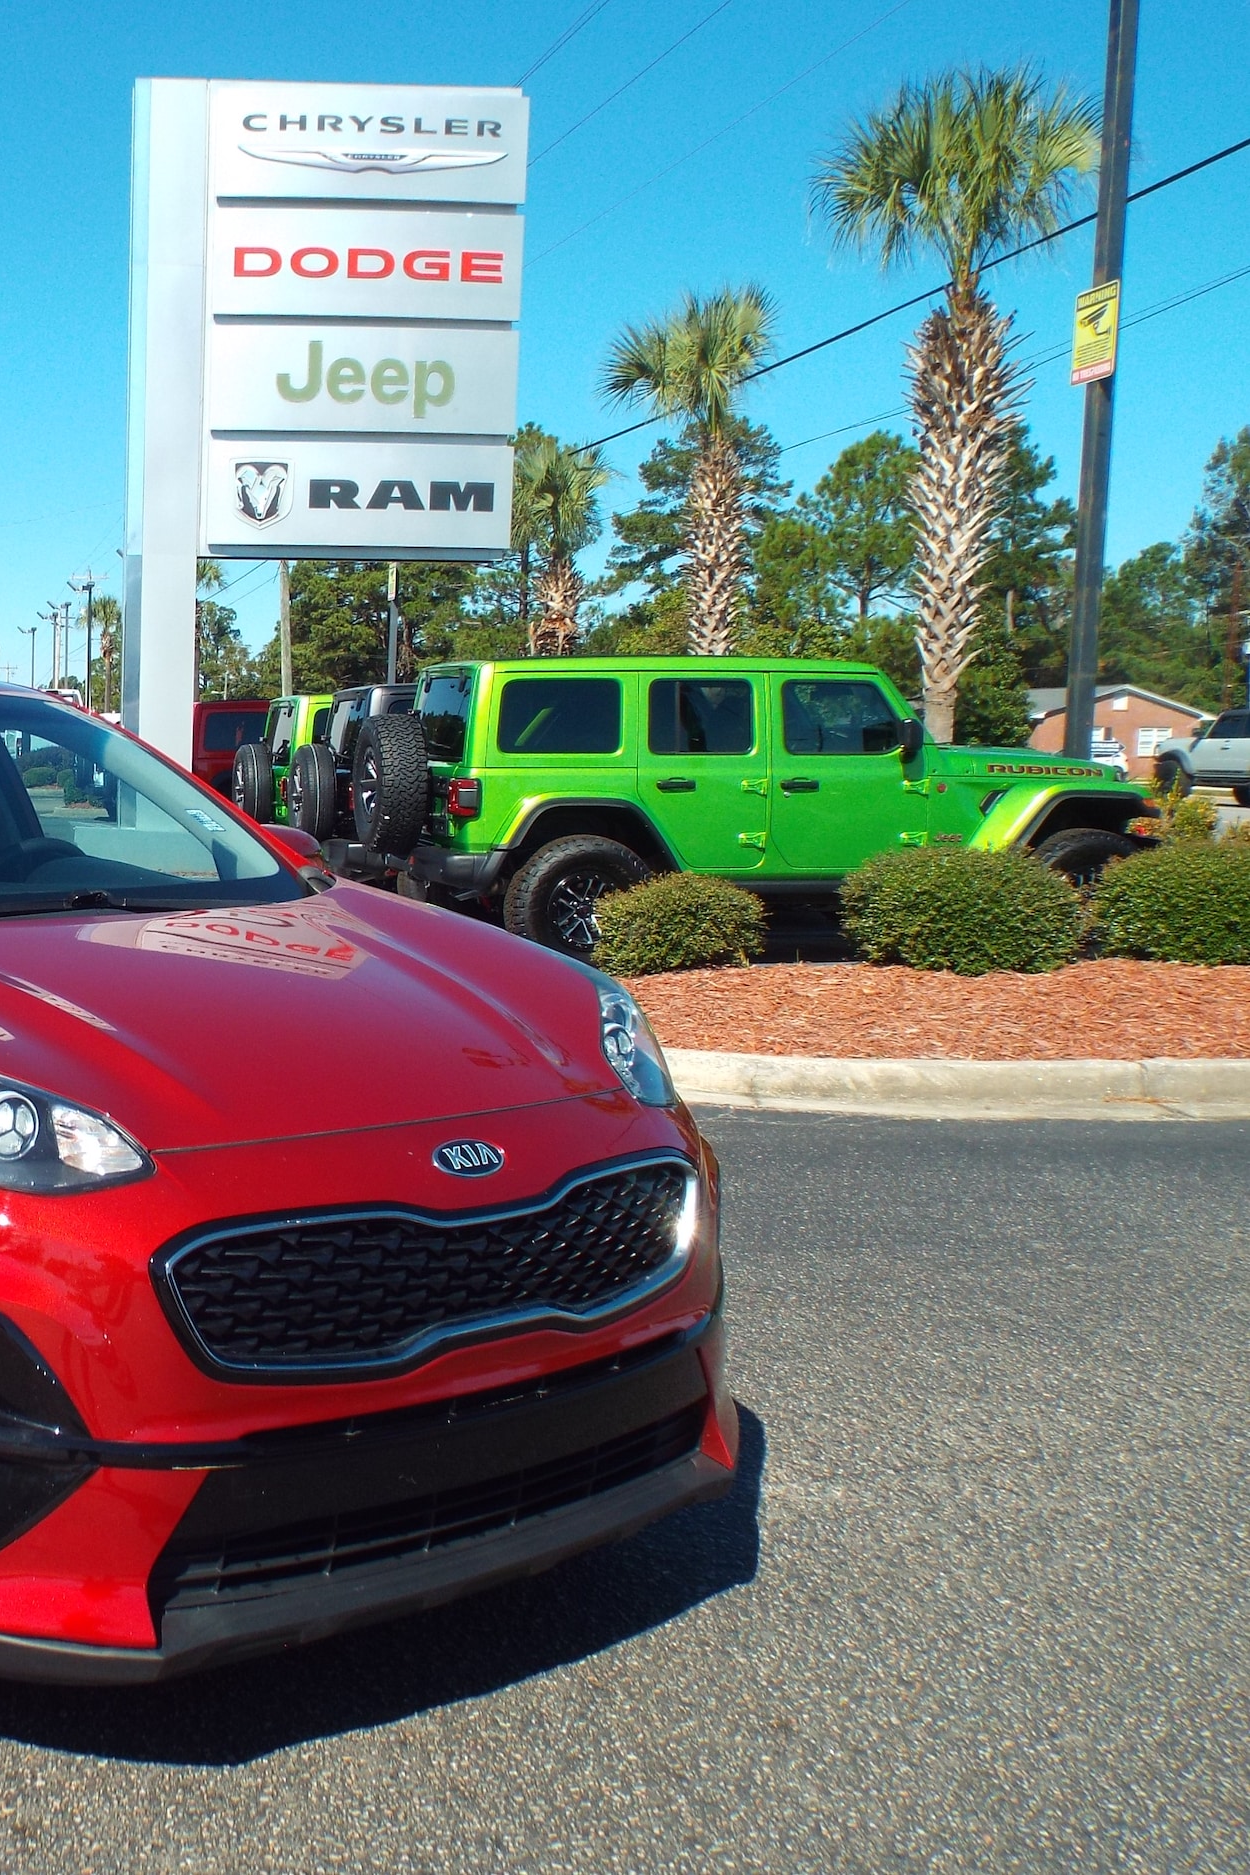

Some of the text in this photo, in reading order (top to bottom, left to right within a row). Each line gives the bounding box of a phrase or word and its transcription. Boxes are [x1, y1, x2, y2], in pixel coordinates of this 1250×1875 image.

[241, 113, 503, 139] CHRYSLER
[233, 246, 504, 284] DODGE
[275, 339, 457, 420] Jeep
[307, 478, 496, 513] RAM
[986, 763, 1105, 778] RUBICON
[933, 832, 963, 843] Jeep
[442, 1142, 499, 1170] KIA
